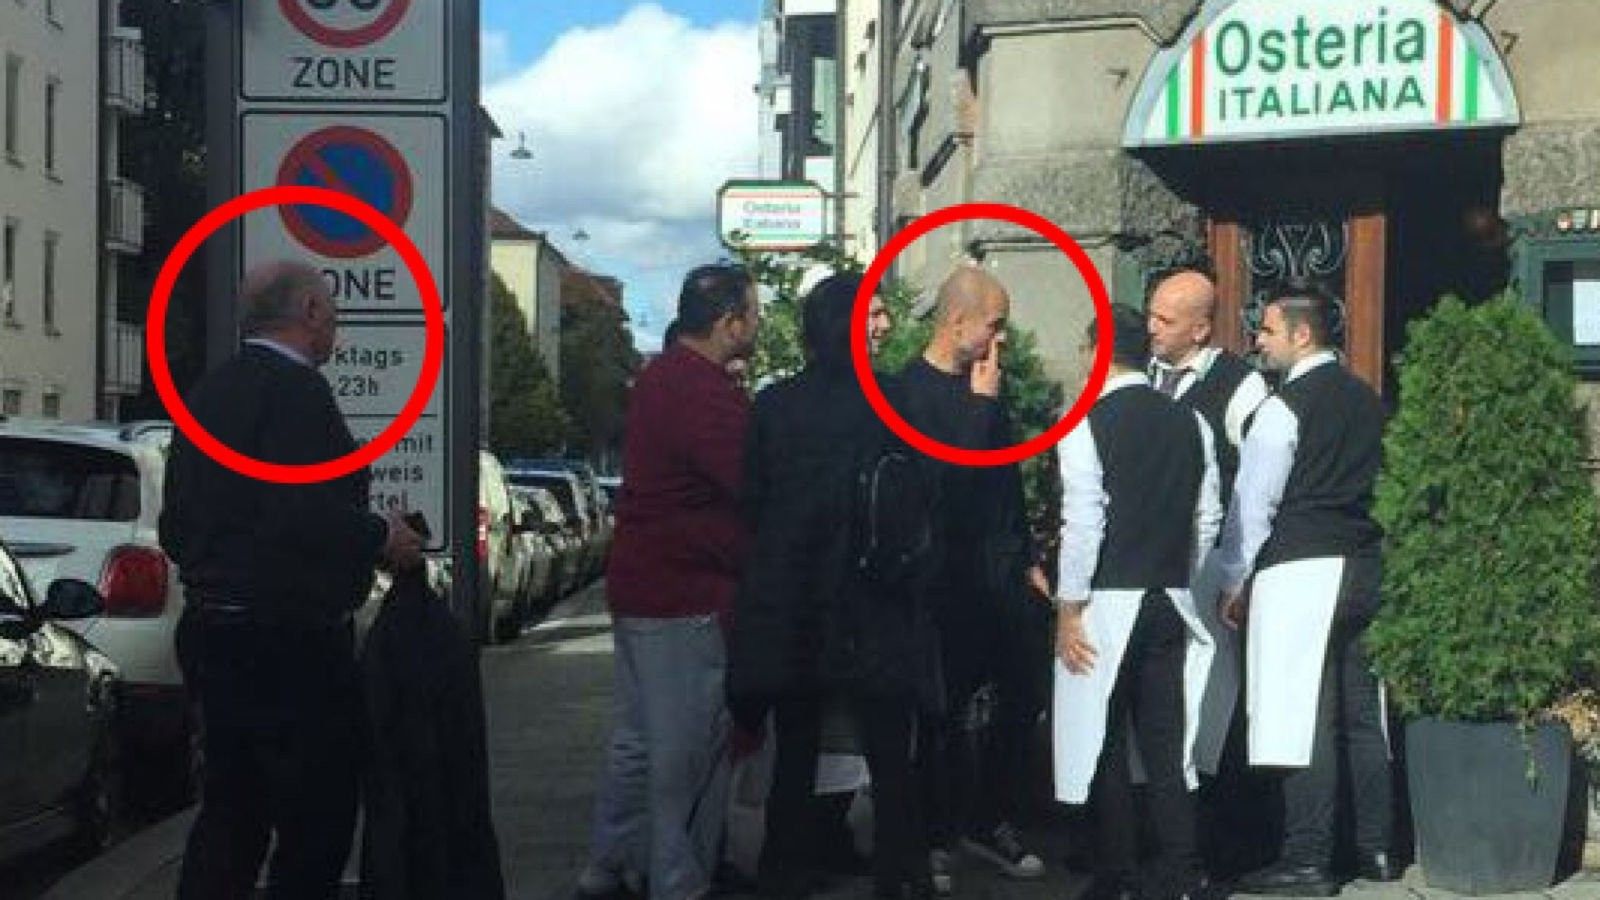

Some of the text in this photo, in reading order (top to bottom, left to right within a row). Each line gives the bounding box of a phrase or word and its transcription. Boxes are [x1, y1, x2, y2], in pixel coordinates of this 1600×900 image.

[1216, 7, 1424, 75] Osteria
[292, 56, 396, 90] ZONE
[1219, 75, 1425, 120] ITALIANA
[322, 268, 396, 300] ONE
[334, 346, 403, 370] ktags
[337, 374, 379, 397] 23h
[372, 460, 424, 483] weis
